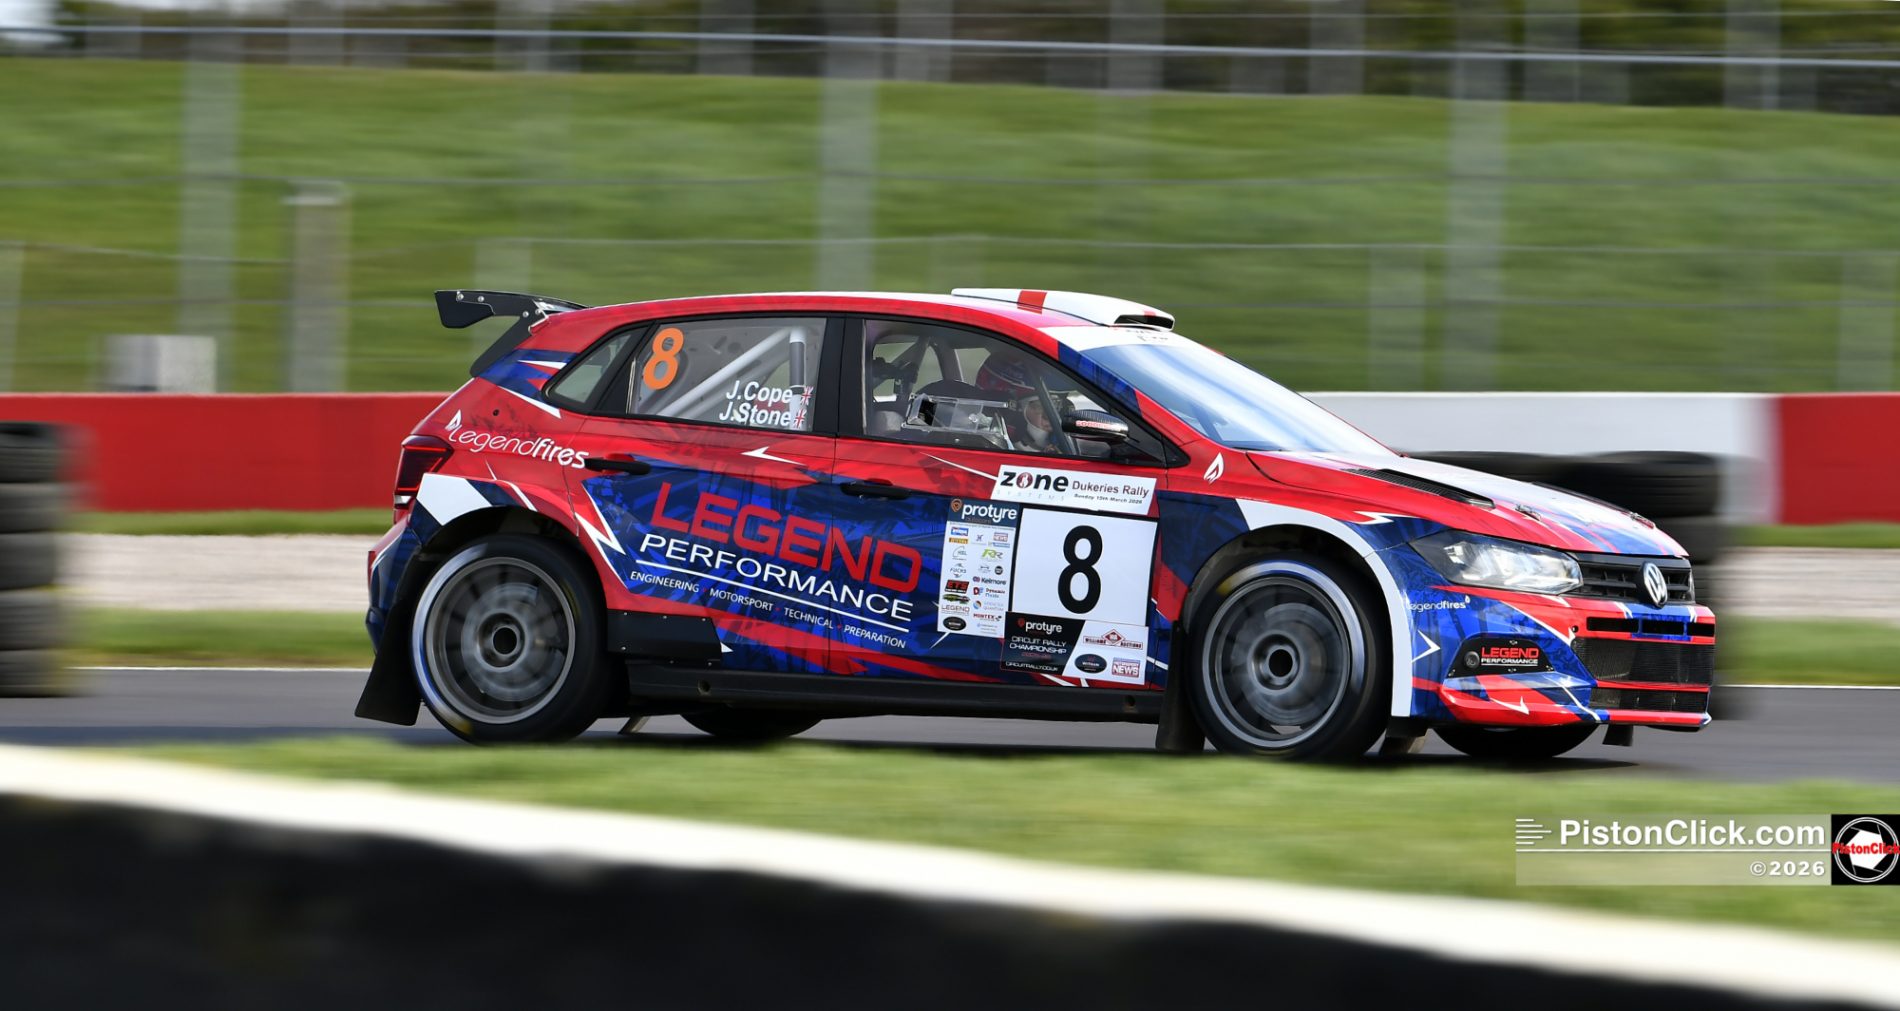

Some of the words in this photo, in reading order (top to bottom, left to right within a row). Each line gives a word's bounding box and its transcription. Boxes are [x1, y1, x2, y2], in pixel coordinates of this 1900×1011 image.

[642, 327, 684, 390] 8
[726, 380, 793, 407] J.Cope
[719, 401, 792, 426] J.Stone
[1000, 471, 1069, 492] zone
[1072, 480, 1119, 494] Dukeries
[1122, 485, 1150, 498] Rally
[961, 504, 1018, 523] protyre
[650, 481, 922, 593] LEGEND
[640, 533, 914, 622] PERFORMANCE
[1057, 525, 1103, 615] 8
[630, 571, 699, 593] ENGINEERING
[710, 588, 773, 612] MOTORSPORT
[783, 606, 834, 630] TECHNICAL
[844, 624, 906, 649] PREPARATION
[941, 604, 970, 612] LEGEND
[1025, 621, 1063, 635] protyre
[1009, 642, 1067, 654] CHAMPIONSHIP
[1011, 636, 1041, 645] CIRCUIT
[1042, 639, 1067, 647] RALLY
[1481, 647, 1539, 658] LEGEND
[1112, 663, 1139, 675] NEWS
